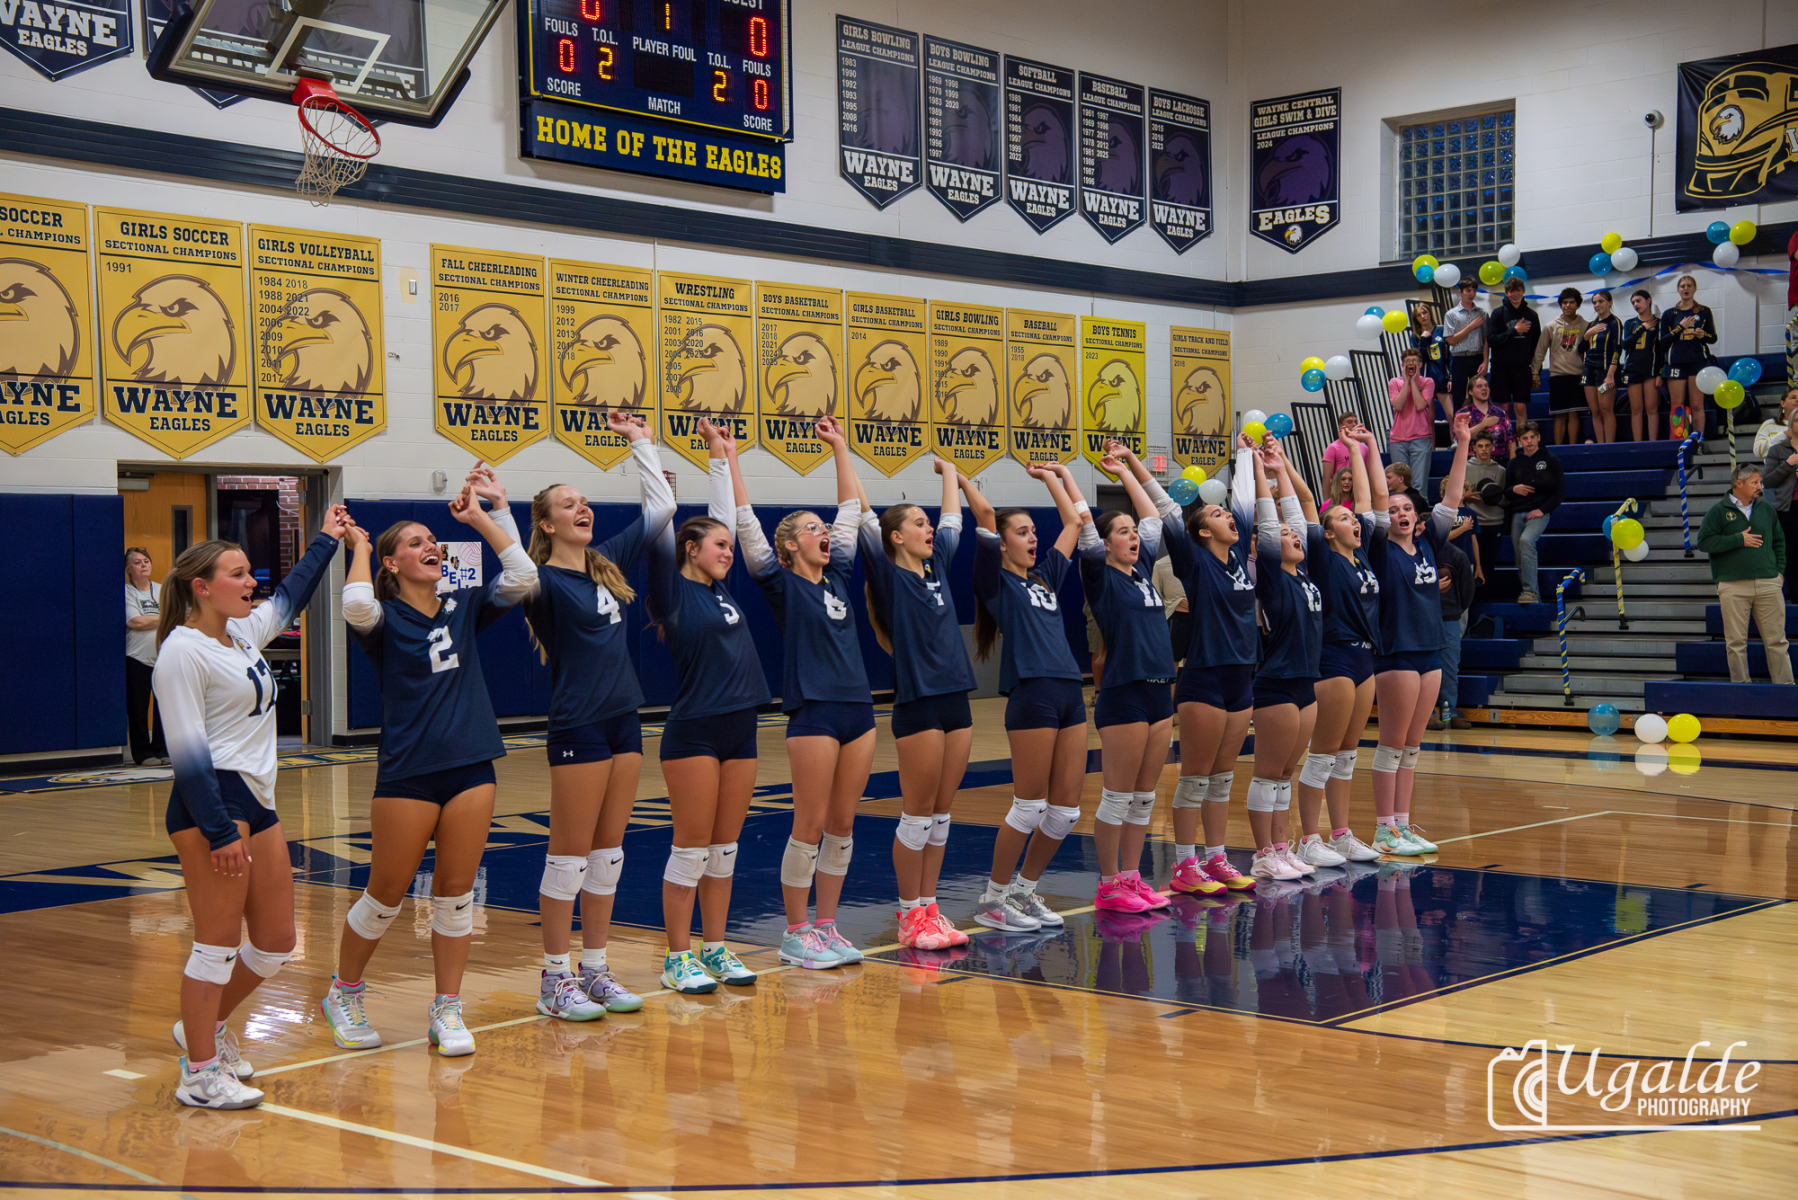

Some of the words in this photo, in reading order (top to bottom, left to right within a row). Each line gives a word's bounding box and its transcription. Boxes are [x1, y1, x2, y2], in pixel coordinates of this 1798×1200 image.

[545, 17, 578, 37] FOULS
[18, 29, 87, 56] EAGLES
[592, 28, 618, 45] T.O.L.
[750, 16, 766, 56] 0
[843, 25, 868, 41] GIRLS
[871, 30, 910, 50] BOWLING
[559, 39, 574, 72] 0
[633, 36, 668, 56] PLAYER
[672, 45, 696, 62] FOUL
[841, 39, 870, 53] LEAGUE
[872, 46, 914, 62] CHAMPIONS
[930, 44, 950, 58] BOYS
[952, 49, 989, 68] BOWLING
[598, 48, 612, 79] 2
[708, 52, 731, 69] T.O.L.
[742, 60, 771, 77] FOULS
[842, 57, 857, 67] 1983
[929, 58, 955, 72] LEAGUE
[956, 64, 996, 80] CHAMPIONS
[1018, 65, 1056, 83] SOFTBALL
[547, 78, 581, 96] SCORE
[713, 71, 726, 101] 2
[755, 80, 767, 109] 0
[1009, 77, 1033, 90] LEAGUE
[1035, 83, 1071, 97] CHAMPIONS
[648, 97, 680, 114] MATCH
[1083, 93, 1105, 105] LEAGUE
[1107, 98, 1141, 112] CHAMPIONS
[1154, 96, 1170, 109] BOYS
[1172, 101, 1204, 117] LACROSSE
[1258, 103, 1289, 116] WAYNE
[1291, 96, 1333, 109] CENTRAL
[743, 115, 772, 131] SCORE
[1152, 108, 1173, 120] LEAGUE
[1175, 114, 1206, 127] CHAMPIONS
[1254, 114, 1277, 128] GIRLS
[1280, 110, 1304, 124] SWIM
[1307, 109, 1312, 119] &
[1316, 105, 1336, 117] DIVE
[842, 123, 857, 132] 2016
[1257, 130, 1286, 140] LEAGUE
[1288, 122, 1334, 135] CHAMPIONS
[536, 116, 606, 151] HOME
[617, 130, 644, 157] OF
[653, 136, 696, 166] THE
[706, 145, 781, 179] EAGLES
[1257, 141, 1273, 149] 2024
[844, 151, 913, 183] WAYNE
[864, 176, 898, 191] EAGLES
[930, 165, 993, 196] WAYNE
[948, 189, 979, 204] EAGLES
[1010, 180, 1069, 209] WAYNE
[1027, 203, 1056, 217] EAGLES
[1084, 192, 1139, 220] WAYNE
[0, 206, 62, 228] SOCCER
[1099, 214, 1126, 228] EAGLES
[1153, 203, 1205, 230] WAYNE
[1259, 205, 1330, 231] EAGLES
[8, 229, 80, 245] CHAMPIONS
[120, 222, 167, 239] GIRLS
[174, 228, 229, 246] SOCCER
[1167, 226, 1193, 238] EAGLES
[105, 240, 169, 254] SECTIONAL
[173, 246, 236, 260] CHAMPIONS
[258, 238, 295, 253] GIRLS
[300, 242, 374, 262] VOLLEYBALL
[106, 262, 131, 273] 1991
[258, 256, 314, 269] SECTIONAL
[318, 262, 374, 275] CHAMPIONS
[442, 259, 465, 270] FALL
[468, 262, 537, 278] CHEERLEADING
[259, 277, 282, 287] 1984
[286, 279, 308, 289] 2018
[439, 274, 487, 286] SECTIONAL
[490, 279, 540, 290] CHAMPIONS
[556, 273, 588, 285] WINTER
[592, 278, 648, 290] CHEERLEADING
[439, 293, 459, 302] 2016
[556, 287, 600, 298] SECTIONAL
[603, 291, 648, 302] CHAMPIONS
[675, 282, 734, 299] WRESTLING
[439, 303, 459, 312] 2017
[556, 305, 575, 314] 1999
[664, 297, 704, 308] SECTIONAL
[707, 302, 748, 312] CHAMPIONS
[763, 294, 782, 303] BOYS
[785, 296, 828, 308] BASKETBALL
[260, 304, 282, 314] 2004
[286, 306, 309, 316] 2022
[762, 306, 800, 317] SECTIONAL
[802, 311, 839, 320] CHAMPIONS
[853, 304, 873, 313] GIRLS
[876, 306, 915, 317] BASKETBALL
[936, 310, 960, 321] GIRLS
[963, 313, 998, 326] BOWLING
[556, 316, 575, 326] 2012
[665, 315, 681, 324] 1982
[852, 316, 886, 325] SECTIONAL
[889, 320, 922, 328] CHAMPIONS
[1024, 320, 1057, 331] BASEBALL
[852, 332, 866, 340] 2014
[934, 324, 966, 332] SECTIONAL
[968, 328, 1000, 336] CHAMPIONS
[1011, 331, 1040, 339] SECTIONAL
[1092, 325, 1109, 336] BOYS
[1112, 327, 1136, 338] TENNIS
[1086, 338, 1113, 346] SECTIONAL
[1173, 334, 1187, 342] GIRLS
[1188, 336, 1204, 344] TRACK
[556, 351, 575, 360] 2018
[1670, 368, 1680, 377] 15
[113, 386, 237, 418] WAYNE
[264, 393, 374, 424] WAYNE
[150, 417, 210, 431] EAGLES
[443, 403, 539, 430] WAYNE
[296, 423, 349, 436] EAGLES
[471, 429, 518, 442] EAGLES
[855, 424, 921, 446] WAYNE
[585, 435, 628, 447] EAGLES
[937, 428, 999, 449] WAYNE
[1014, 431, 1071, 452] WAYNE
[786, 443, 822, 453] EAGLES
[874, 446, 906, 456] EAGLES
[954, 449, 985, 459] EAGLES
[1176, 438, 1225, 457] WAYNE
[1030, 452, 1058, 461] EAGLES
[1154, 456, 1166, 471] EXIT
[1191, 457, 1216, 465] EAGLES
[596, 584, 621, 624] 4
[427, 625, 460, 674] 2
